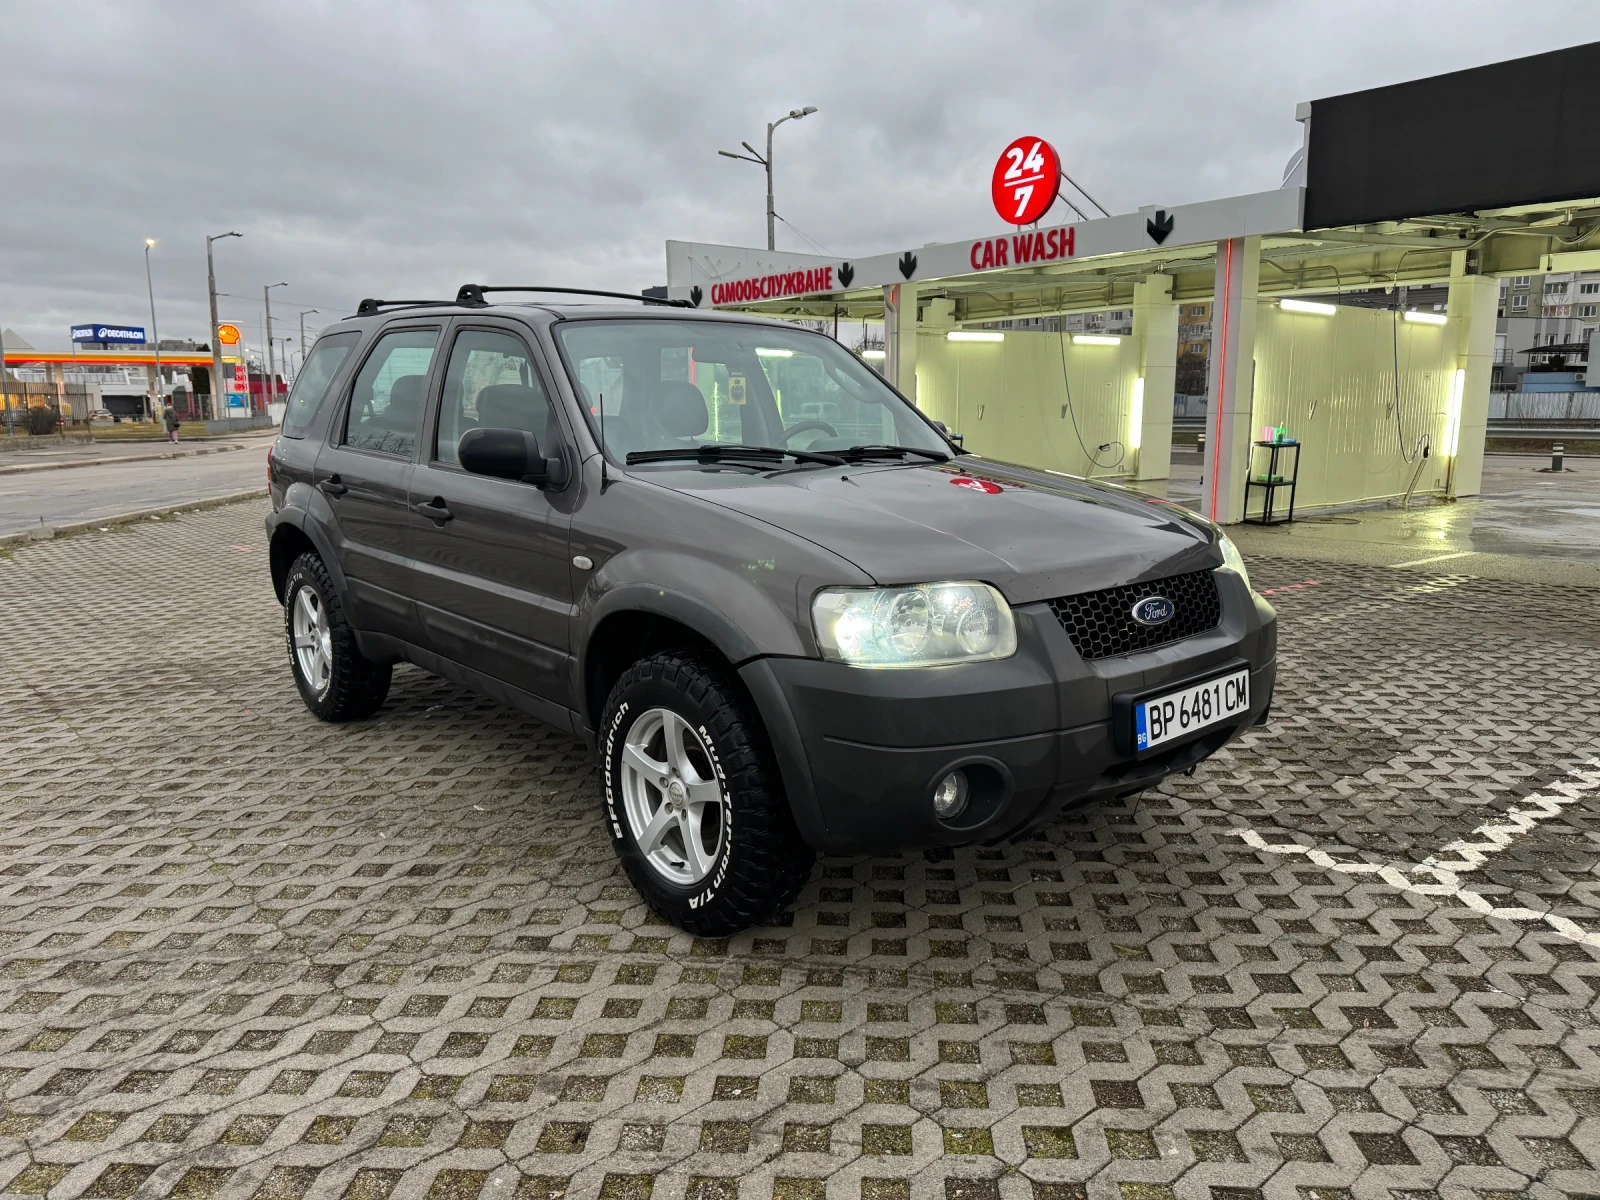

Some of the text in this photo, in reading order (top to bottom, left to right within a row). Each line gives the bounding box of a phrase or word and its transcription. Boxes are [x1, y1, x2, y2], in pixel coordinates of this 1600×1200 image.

[1004, 141, 1045, 180] 24
[1013, 184, 1034, 218] 7
[970, 227, 1075, 269] CAR WASH
[711, 266, 832, 304] САМООБСЛУЖВАНЕ
[107, 329, 144, 340] DECATHLON
[1144, 601, 1168, 620] Ford
[1149, 675, 1247, 741] BP 6481 CM
[1137, 732, 1147, 745] BG
[604, 701, 630, 839] BFGoodrich
[688, 724, 732, 910] Mud-Terrain T/A
